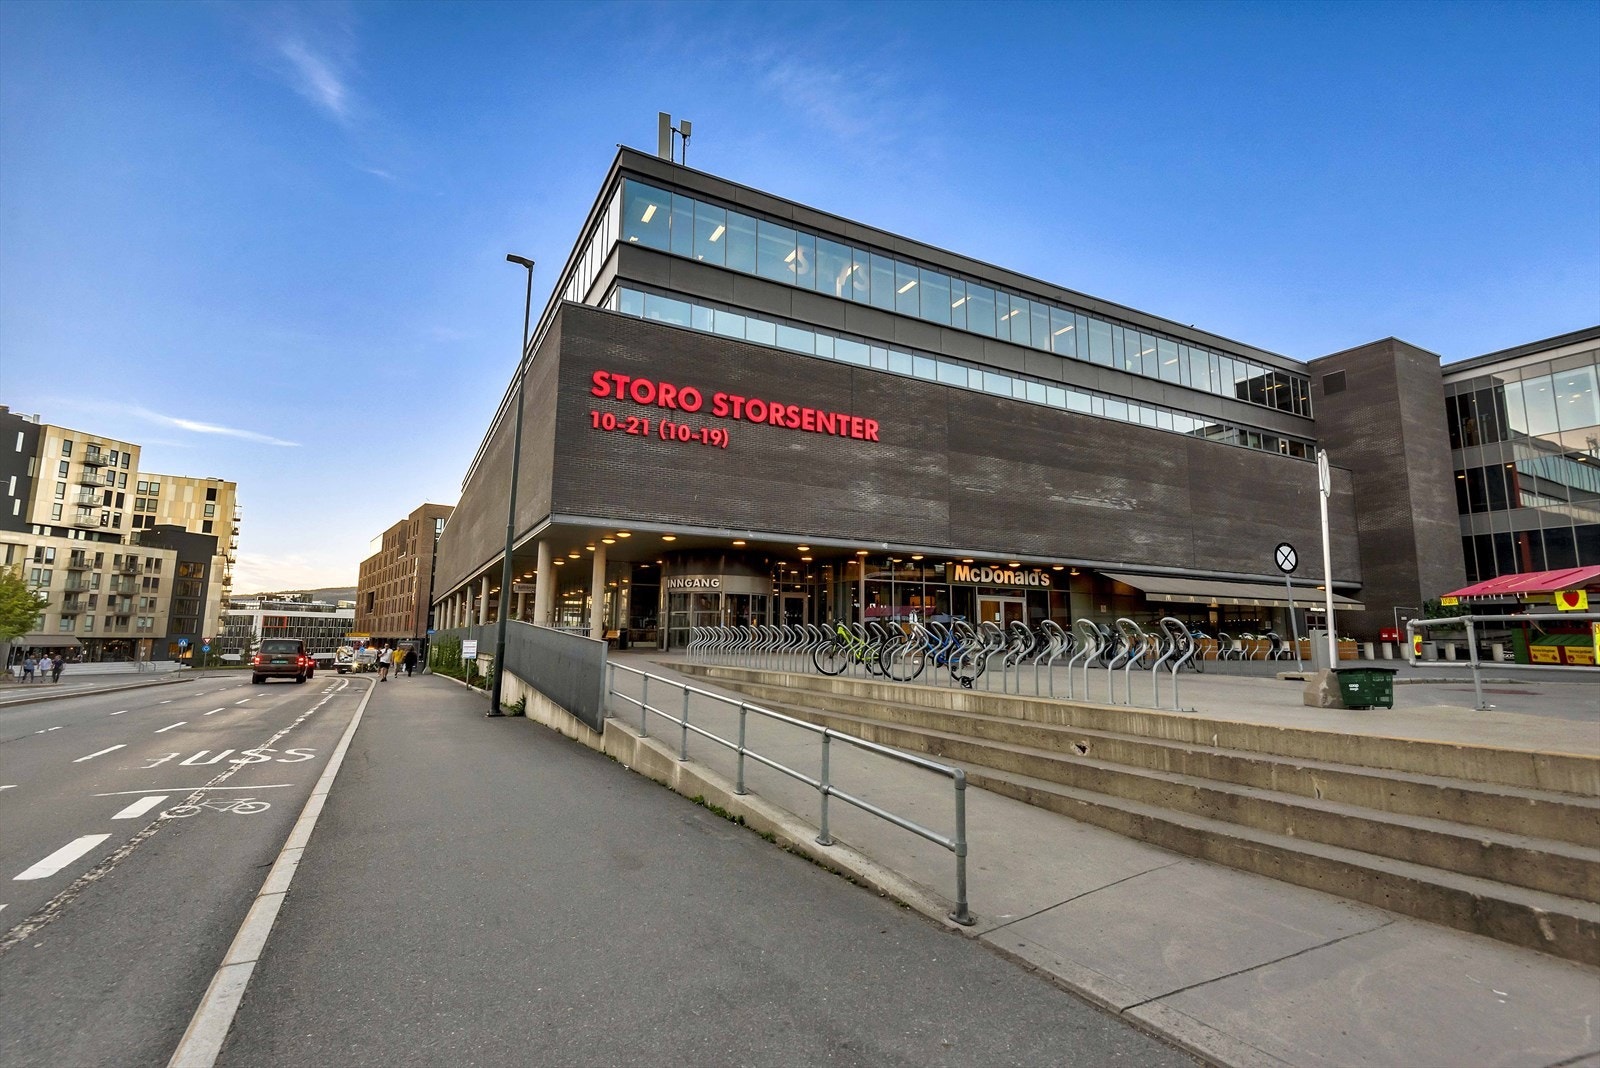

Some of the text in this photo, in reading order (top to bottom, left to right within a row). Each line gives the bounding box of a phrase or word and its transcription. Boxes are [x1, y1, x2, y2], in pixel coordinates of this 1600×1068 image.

[591, 370, 879, 443] STORO STORSENTER
[591, 410, 730, 449] 10-21 (10-19)
[667, 578, 720, 588] INNGANG
[954, 564, 1050, 586] McDonald's
